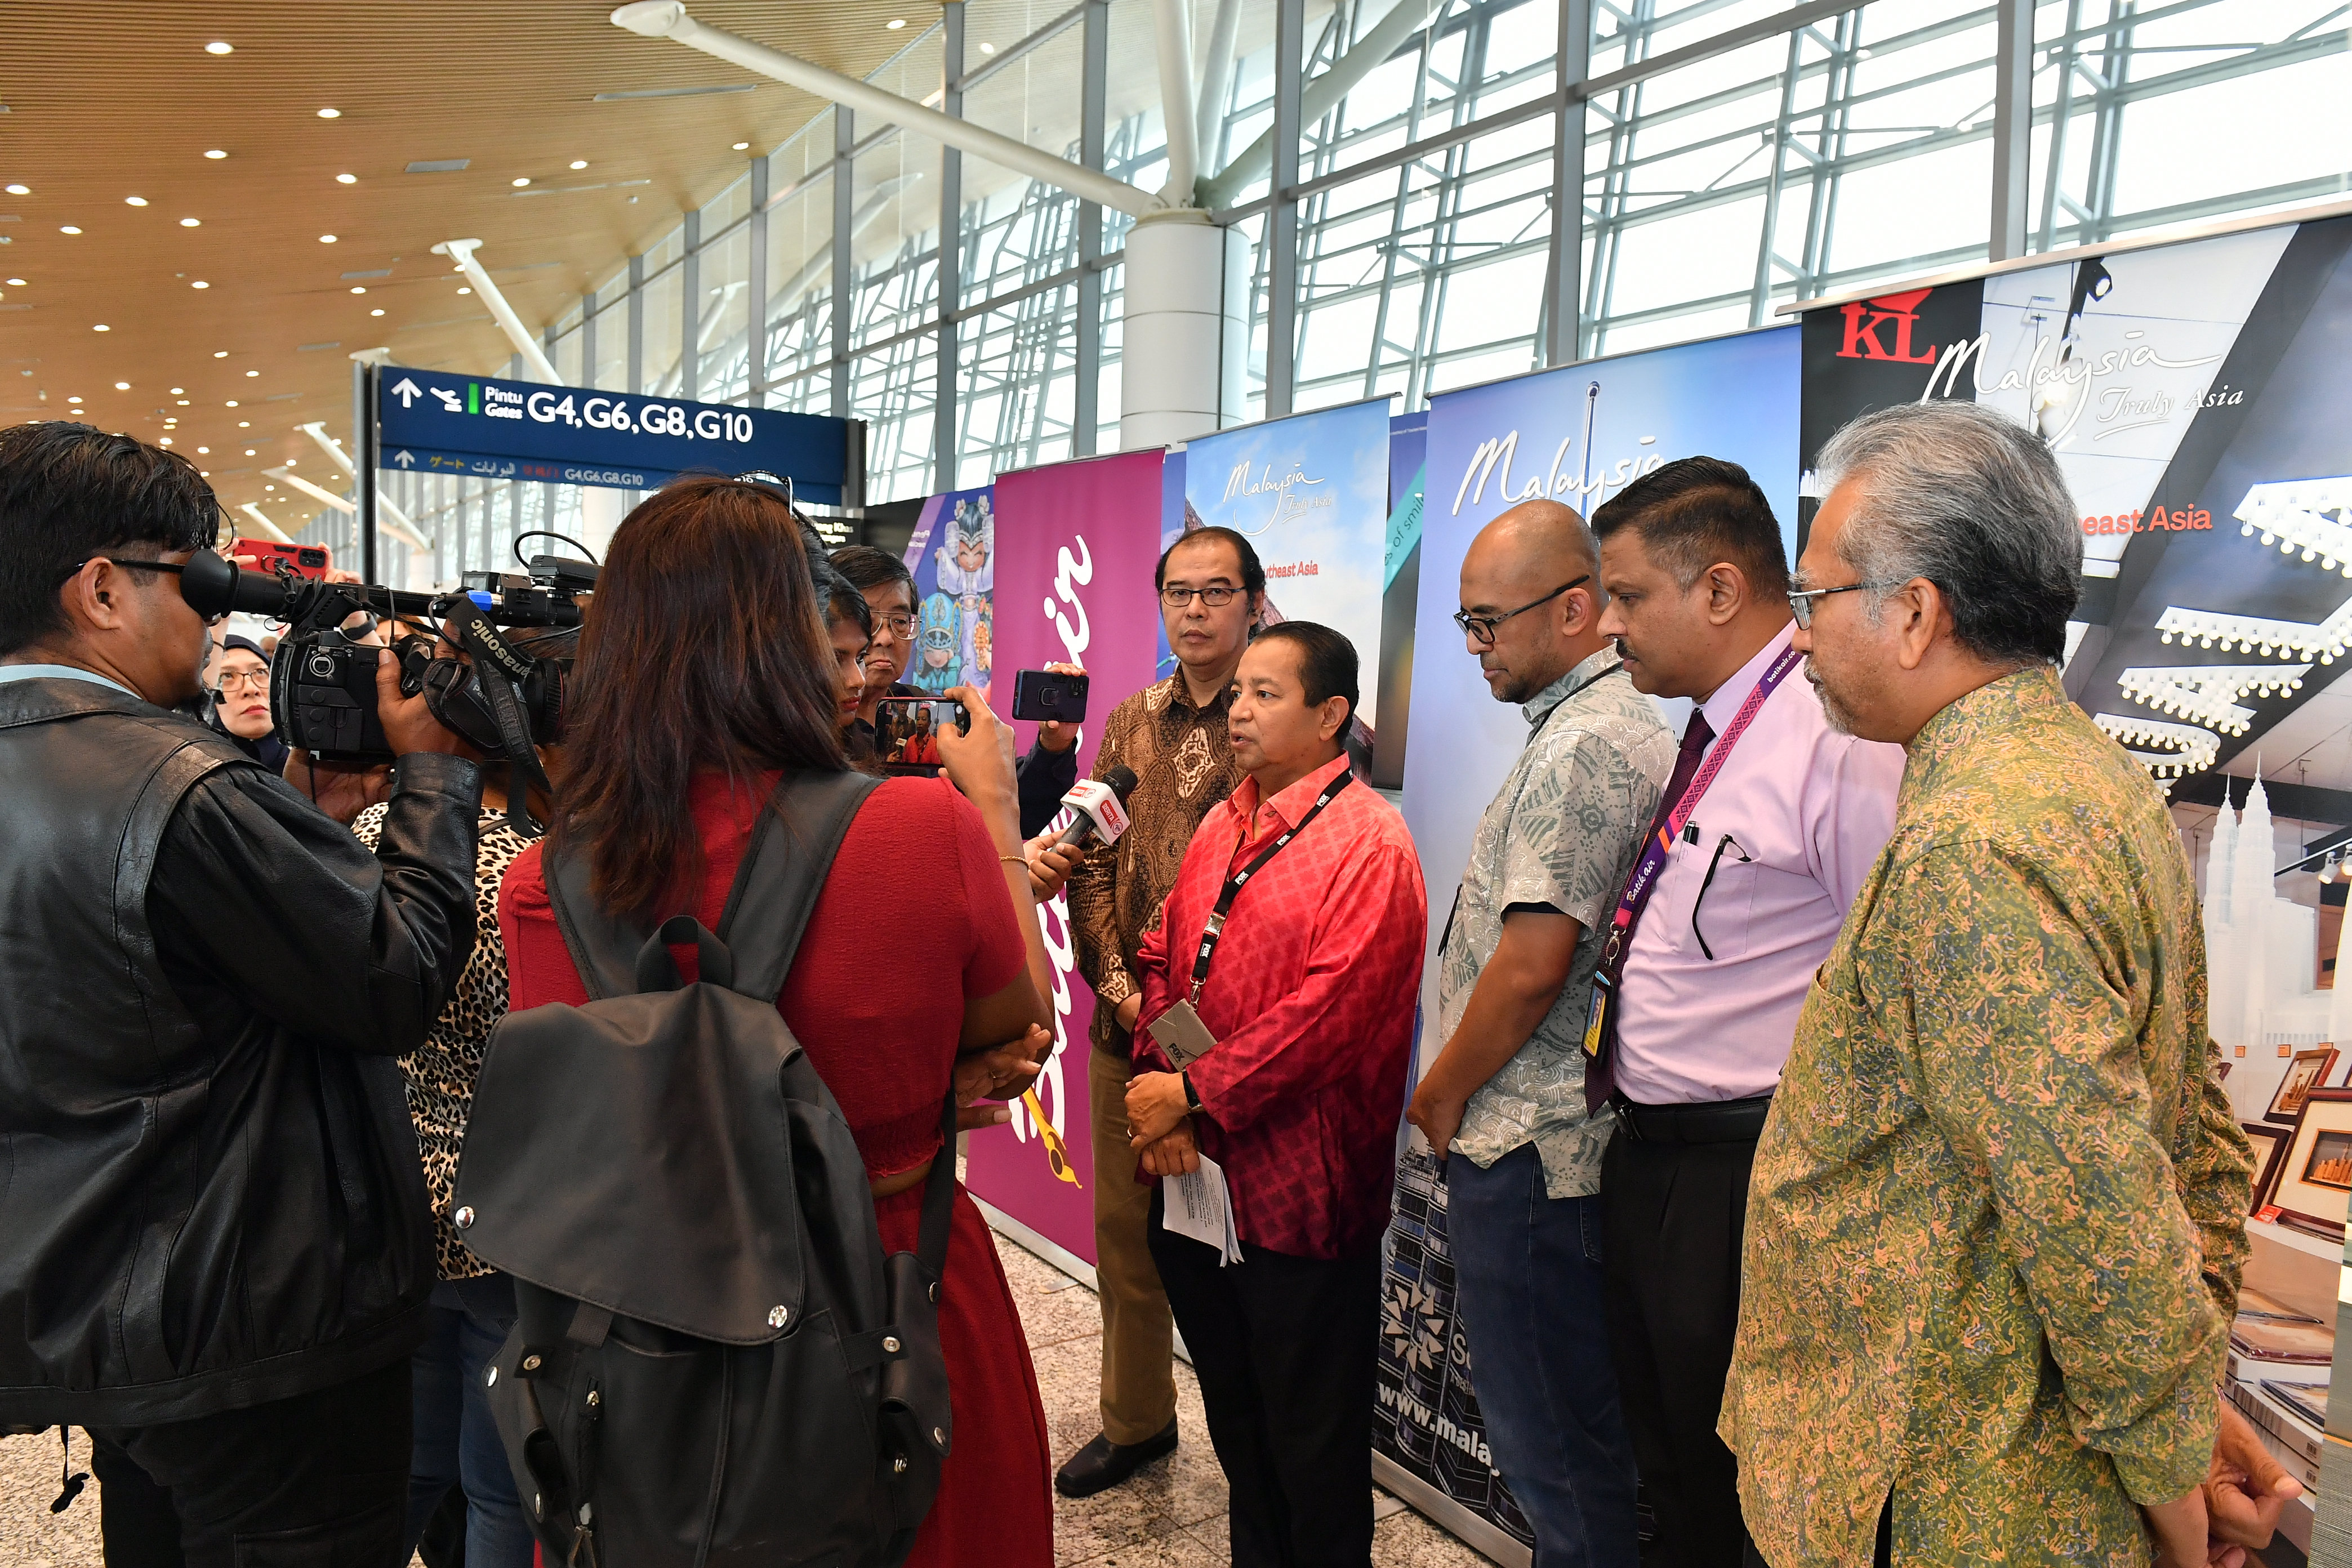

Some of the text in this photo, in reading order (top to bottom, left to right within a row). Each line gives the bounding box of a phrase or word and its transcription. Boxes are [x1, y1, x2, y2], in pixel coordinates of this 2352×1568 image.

[1836, 305, 1936, 364] KL
[485, 386, 523, 404] Pintu
[1920, 331, 2221, 448] Malaysia
[484, 402, 523, 419] Gates
[2097, 385, 2244, 422] Truly Asia
[1223, 460, 1325, 536] Malaysia
[1284, 494, 1331, 514] Truly Asia
[2078, 503, 2213, 535] east Asia
[1297, 560, 1318, 576] Asia
[1316, 794, 1330, 807] FOX
[1102, 802, 1115, 822] BERITA
[1276, 834, 1290, 846] FOX
[1235, 871, 1249, 885] FOX
[1627, 860, 1655, 901] Batik air
[1201, 943, 1211, 958] FOX
[1168, 1043, 1185, 1062] FOX
[1378, 1382, 1500, 1477] www.mala
